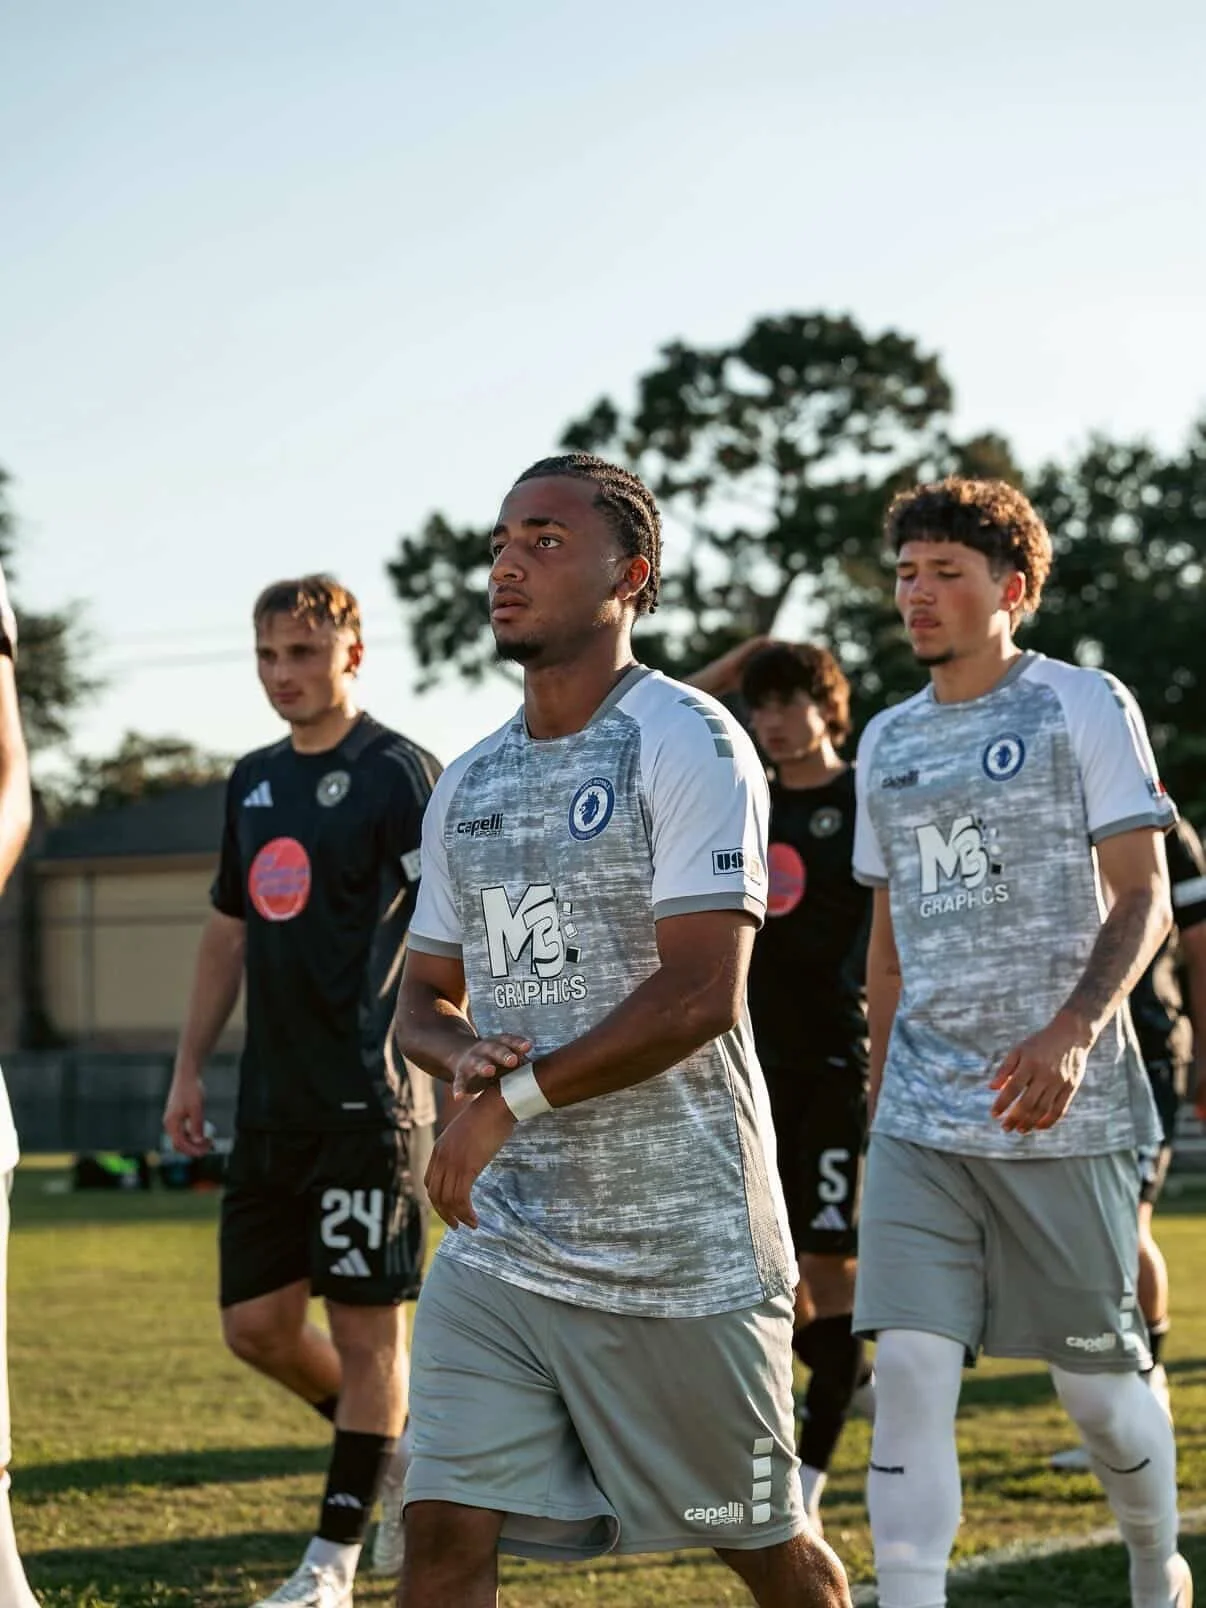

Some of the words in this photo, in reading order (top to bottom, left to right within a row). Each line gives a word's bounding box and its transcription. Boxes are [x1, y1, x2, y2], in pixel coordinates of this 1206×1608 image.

[457, 813, 504, 836] capelli
[920, 884, 1009, 918] GRAPHCS
[480, 882, 565, 979] M3
[493, 974, 588, 1009] GRAPHICS
[320, 1188, 384, 1250] 24
[684, 1501, 744, 1524] capelli
